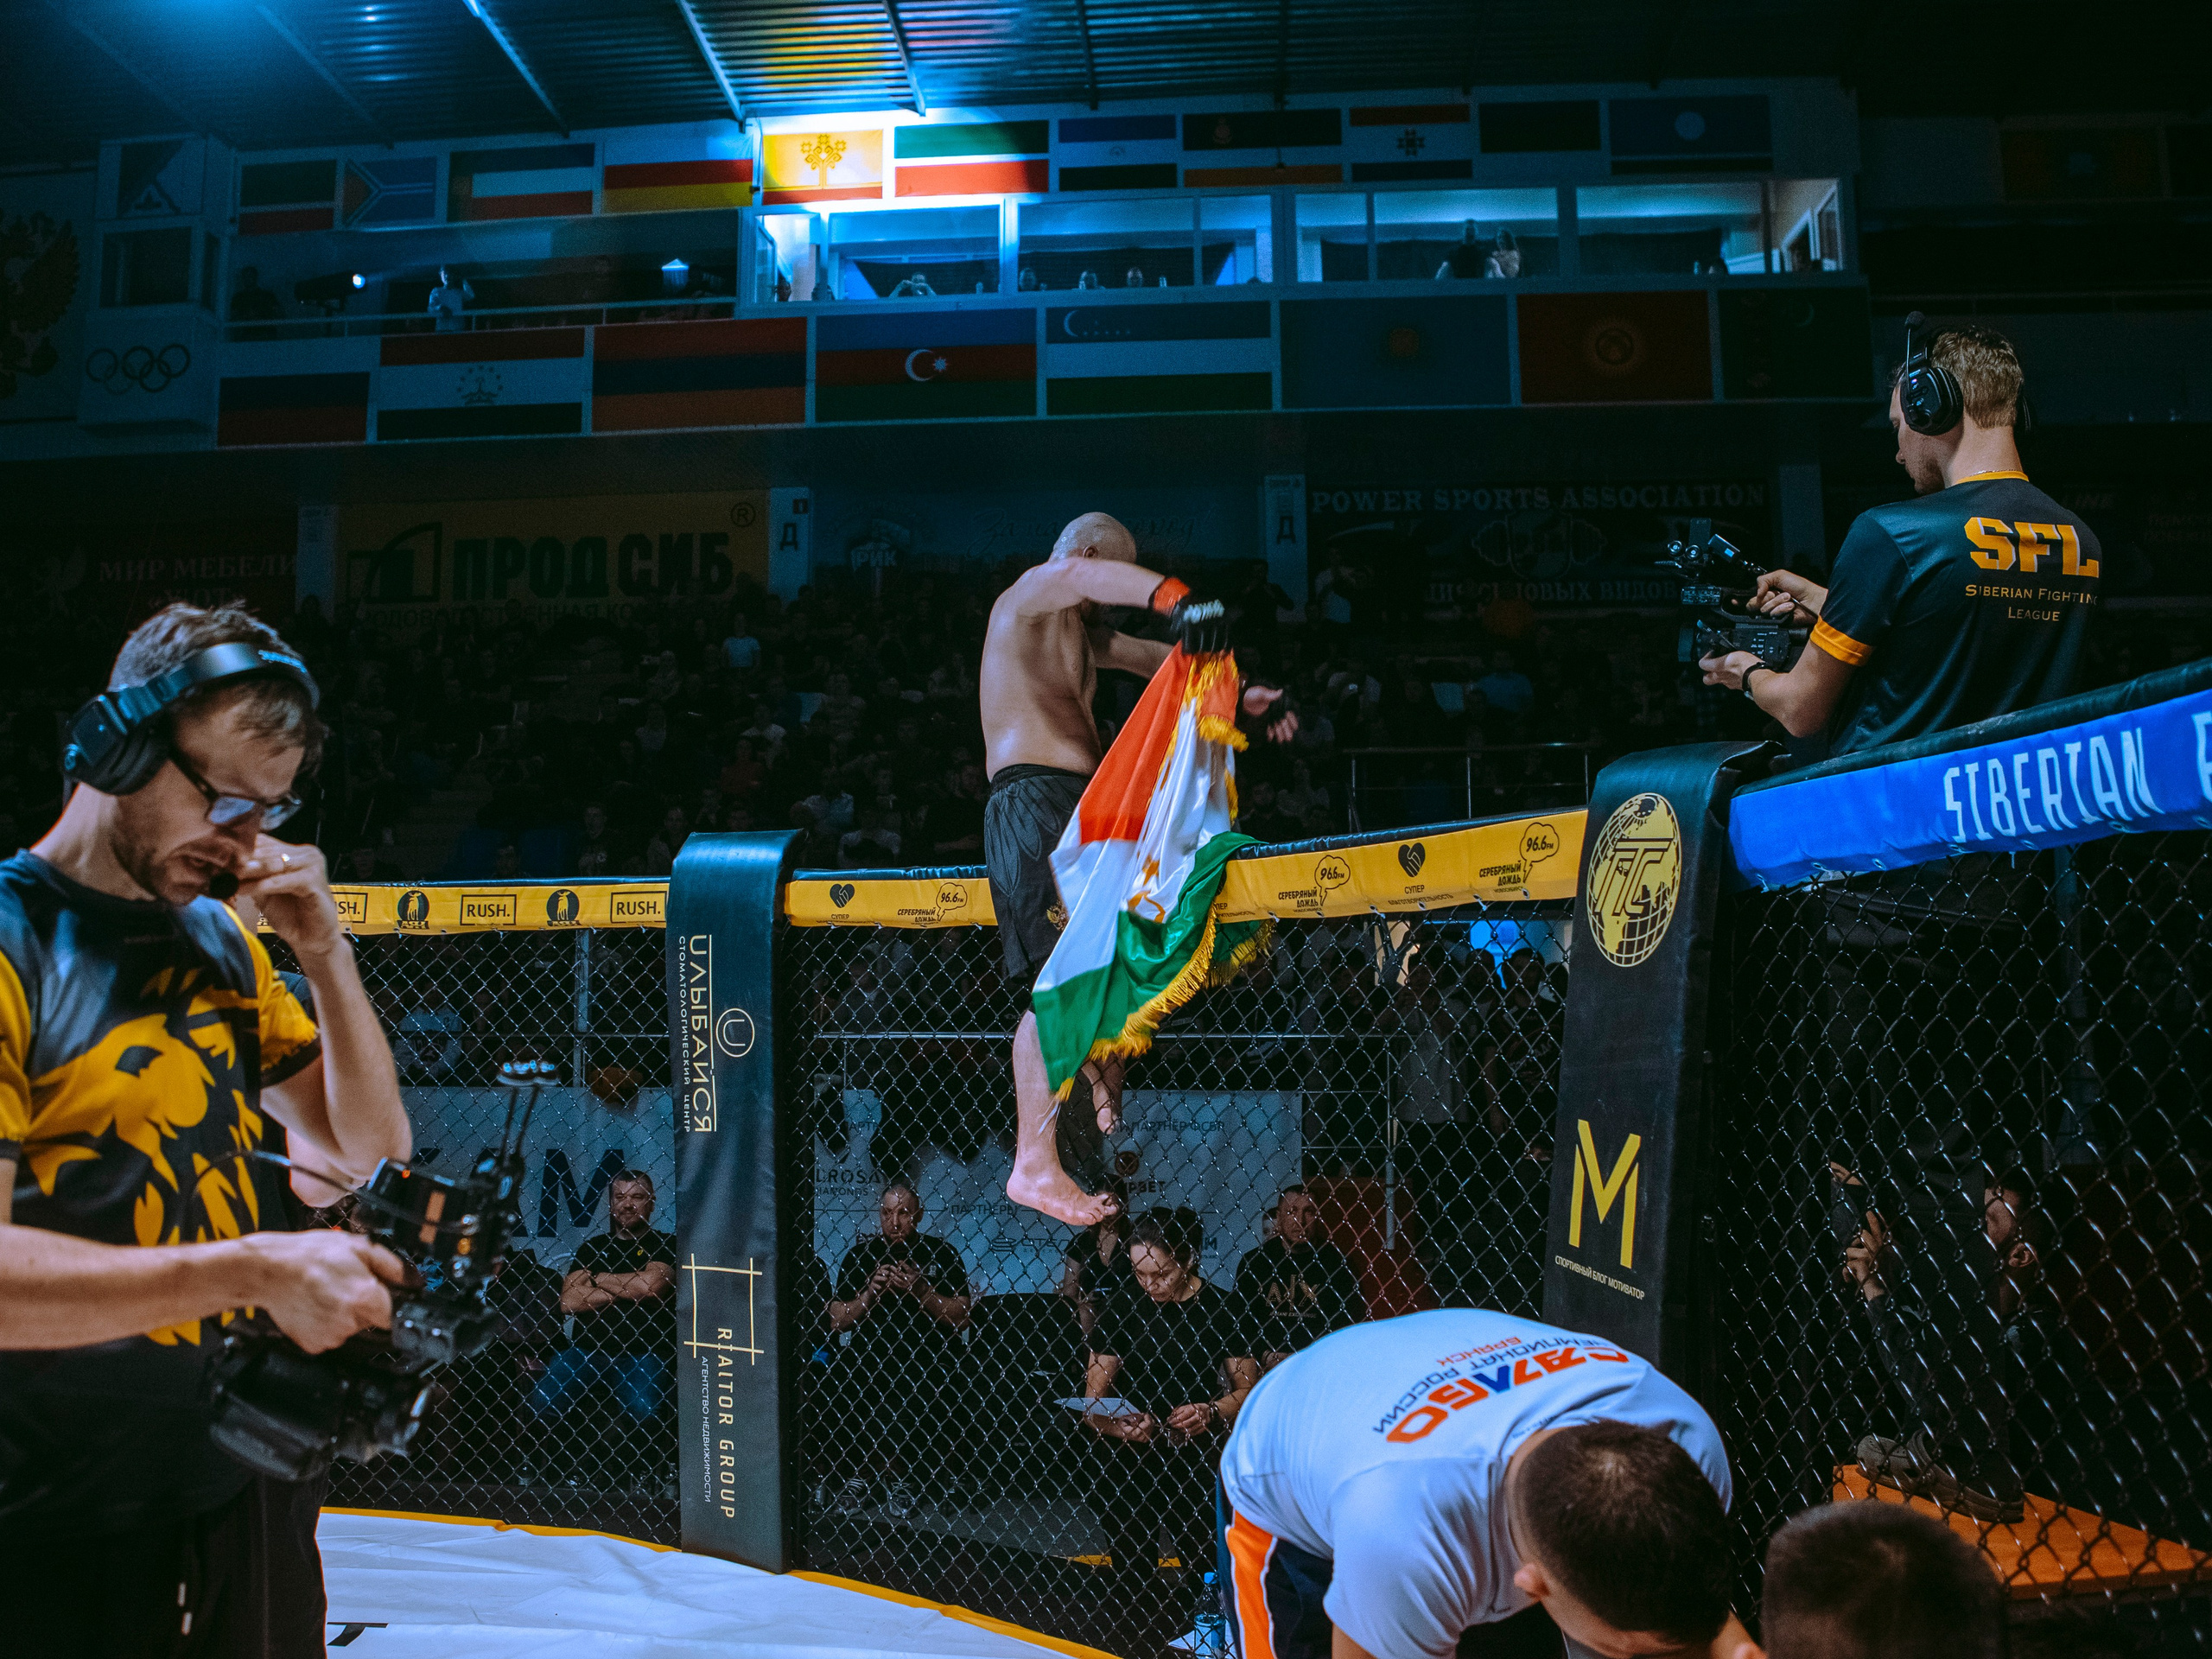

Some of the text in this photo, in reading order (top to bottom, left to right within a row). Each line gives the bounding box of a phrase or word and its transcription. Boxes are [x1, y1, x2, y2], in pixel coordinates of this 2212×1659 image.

[1312, 483, 1768, 514] POWER SPORTS ASSOCIATION
[1964, 517, 2100, 579] SFL
[99, 554, 296, 583] МИР МЕБЕЛИ
[1943, 727, 2165, 843] SIBERIAN
[1478, 860, 1522, 878] СЕРЕБРЯНЫЙ
[1497, 874, 1522, 887] ДОЖДЬ
[1278, 887, 1318, 900] СЕРЕБРЯНЫЙ
[1297, 899, 1319, 908] ДОЖДЬ
[1404, 884, 1425, 894] СУПЕР
[467, 904, 511, 918] RUSH.
[616, 901, 661, 915] RUSH.
[897, 906, 937, 916] СЕРЕБРЯНЫЙ
[678, 935, 690, 1085] СТОМАТОЛОГИЧЕСКИЙ
[1554, 1255, 1645, 1300] СПОРТИВНЫЙ БЛОГ МОТИВАТОР
[1372, 1367, 1460, 1435] РОССИИ
[701, 1356, 711, 1503] АГЕНТСТВО НЕДВИЖИМОСТИ
[719, 1439, 735, 1519] GROUP
